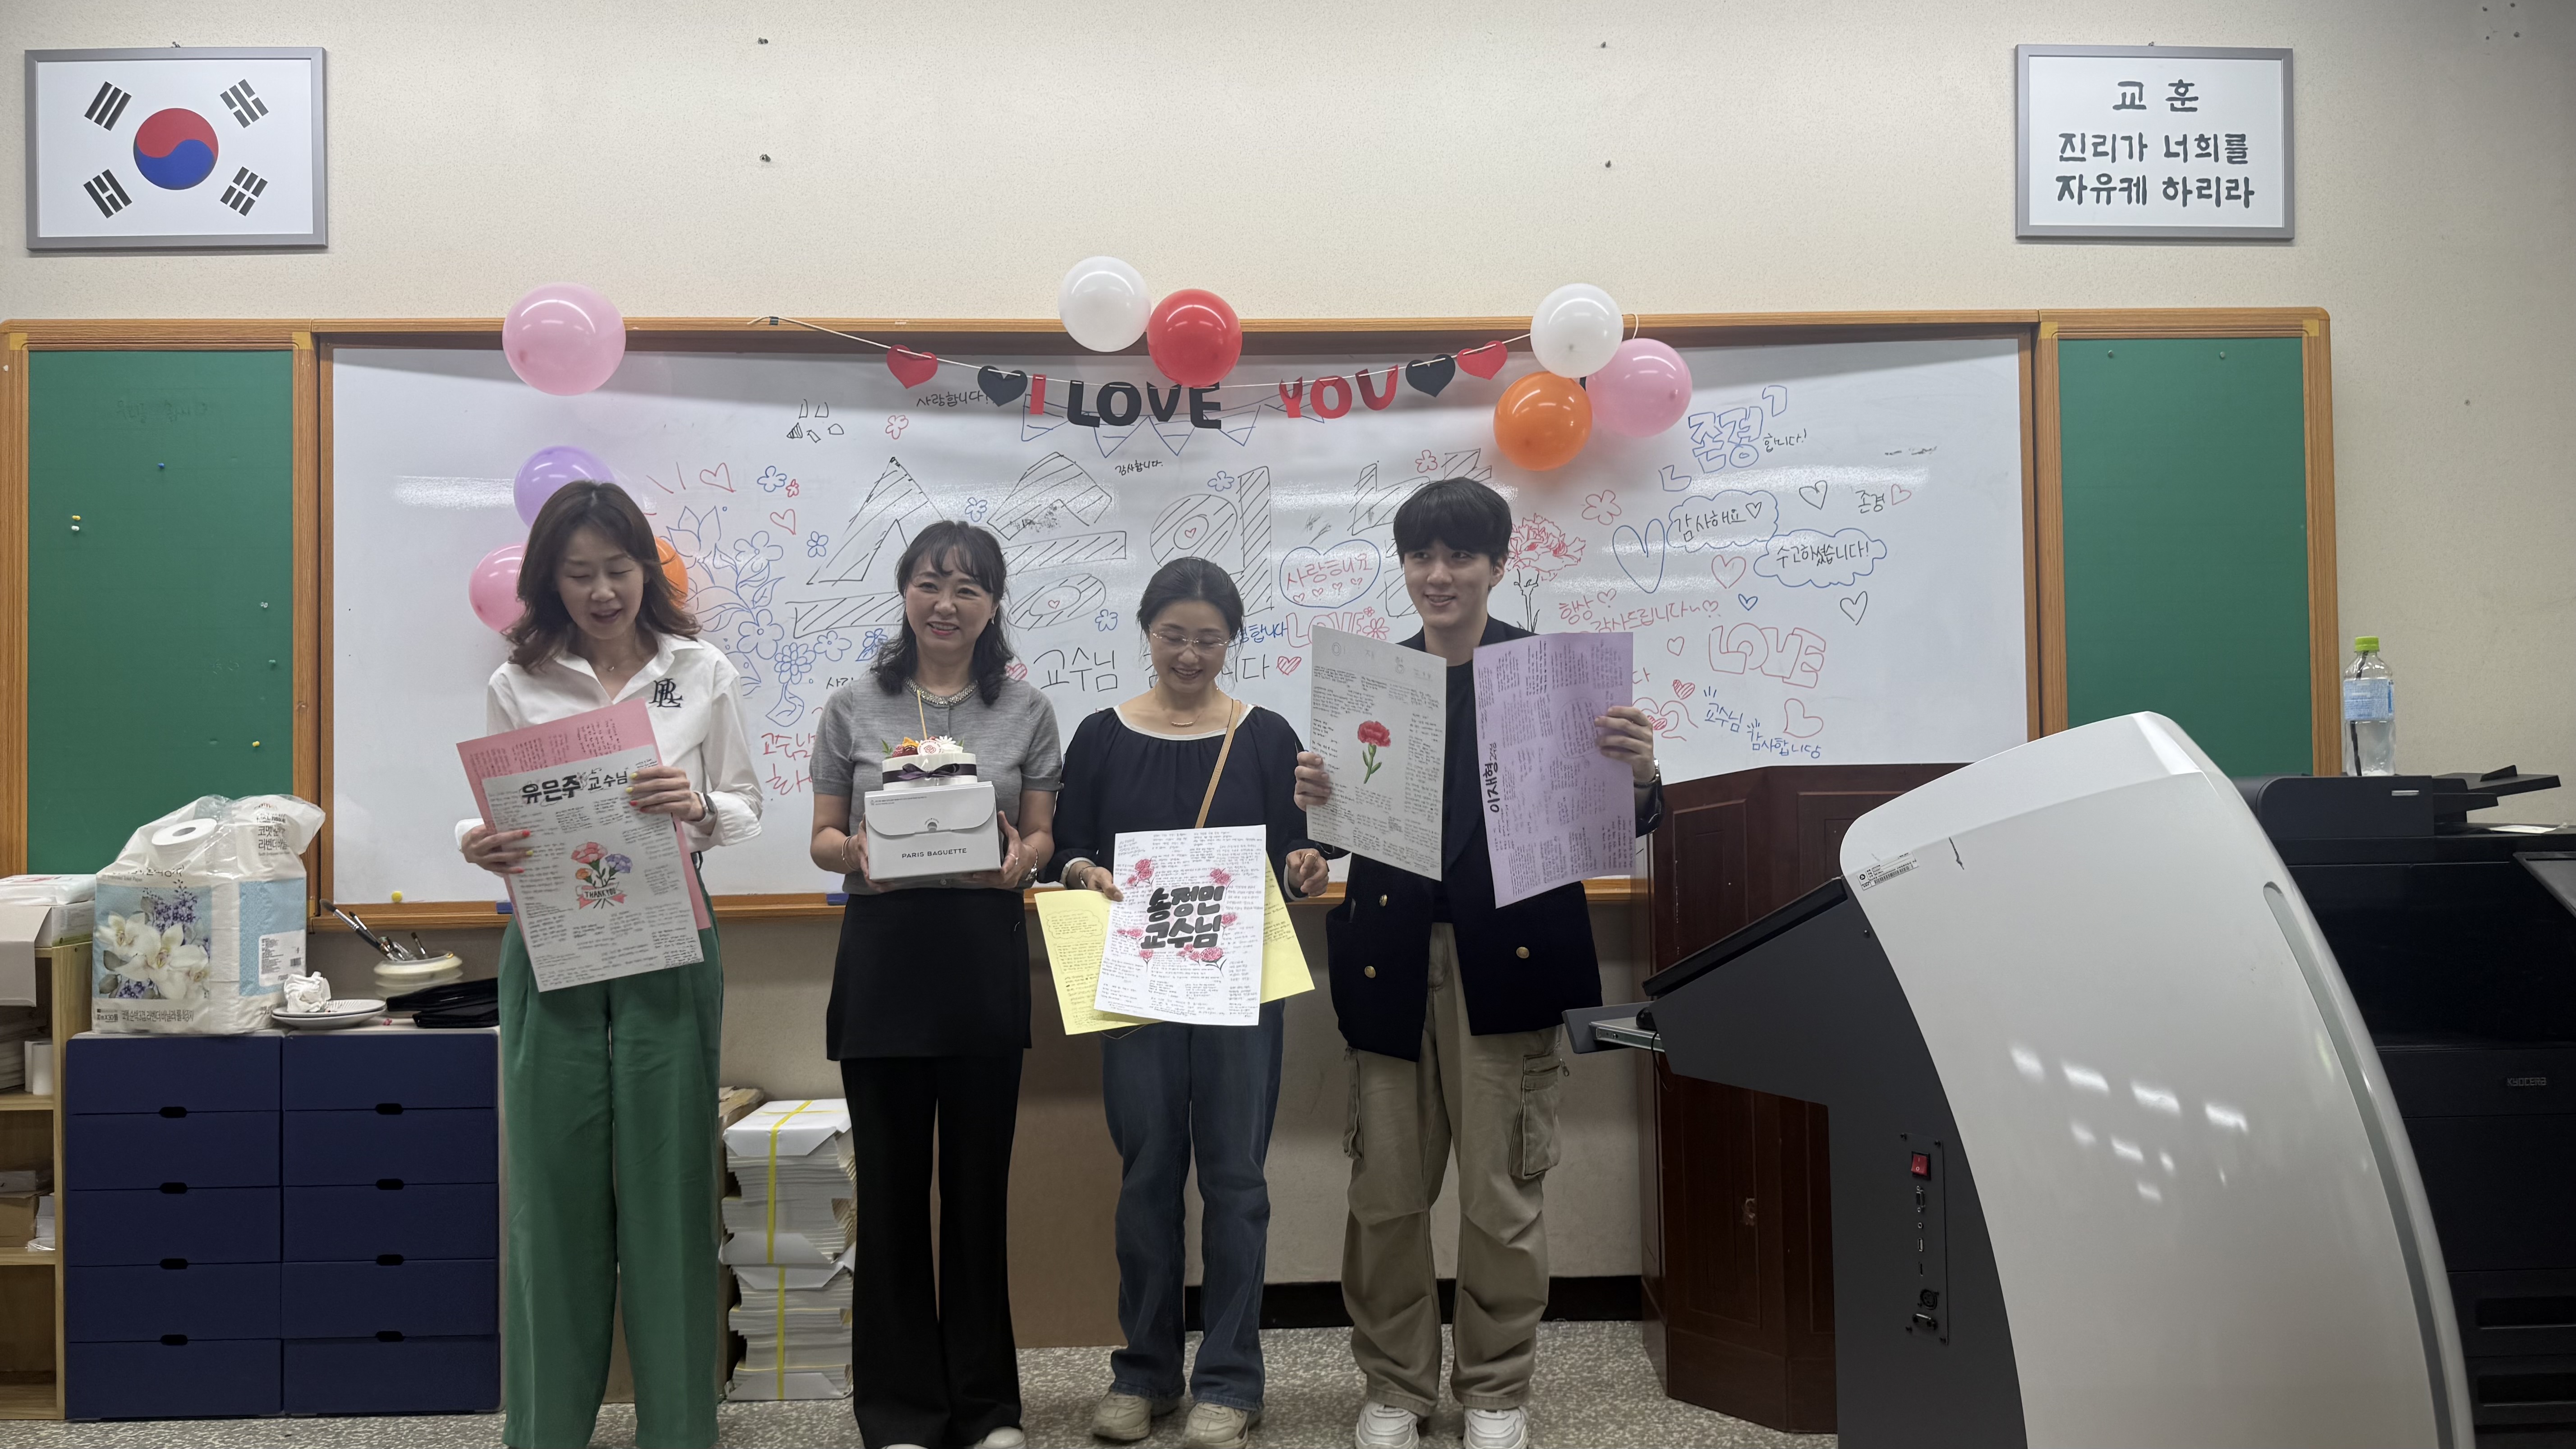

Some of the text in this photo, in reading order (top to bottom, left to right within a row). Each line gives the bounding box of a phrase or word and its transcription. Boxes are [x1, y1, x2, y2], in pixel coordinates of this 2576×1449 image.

[2112, 79, 2199, 112] 교 훈
[2058, 133, 2249, 165] 진리가 너희를
[2055, 173, 2255, 208] 자유케 하리라
[1030, 364, 1399, 429] I LOVE YOU
[1855, 489, 1886, 514] 존경
[1673, 510, 1747, 543] 감사해요
[1776, 540, 1869, 569] 수고하셨습니다!
[1033, 647, 1118, 692] 교수님
[1708, 622, 1826, 688] LOVE
[1704, 703, 1743, 732] 교수님
[1747, 729, 1822, 759] 감사합니당
[588, 770, 628, 791] 교수님
[927, 848, 967, 856] BAGUETTE
[1141, 915, 1222, 950] 교수님
[2507, 1077, 2547, 1086] KYOCERA
